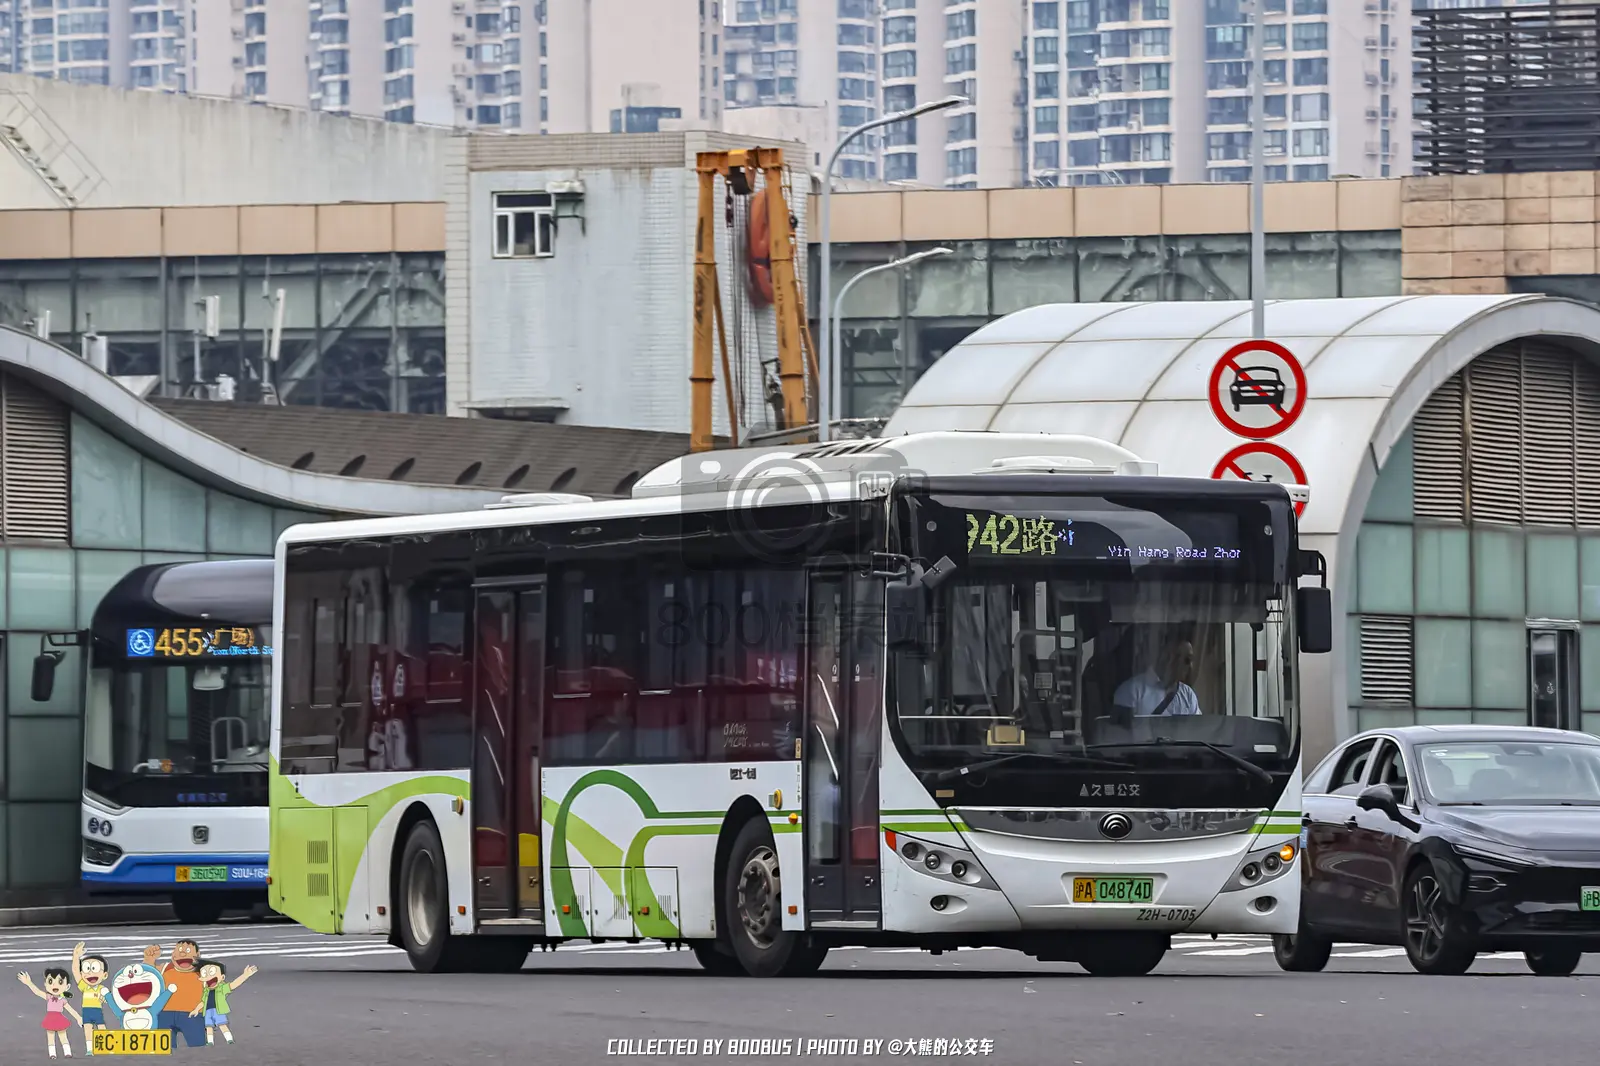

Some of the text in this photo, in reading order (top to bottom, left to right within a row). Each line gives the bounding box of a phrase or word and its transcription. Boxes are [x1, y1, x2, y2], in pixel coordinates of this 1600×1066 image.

[1108, 545, 1132, 558] Yin
[1138, 545, 1169, 559] Hang
[1175, 545, 1207, 559] Road
[154, 628, 203, 656] 455
[1136, 908, 1197, 921] Z2H-0705
